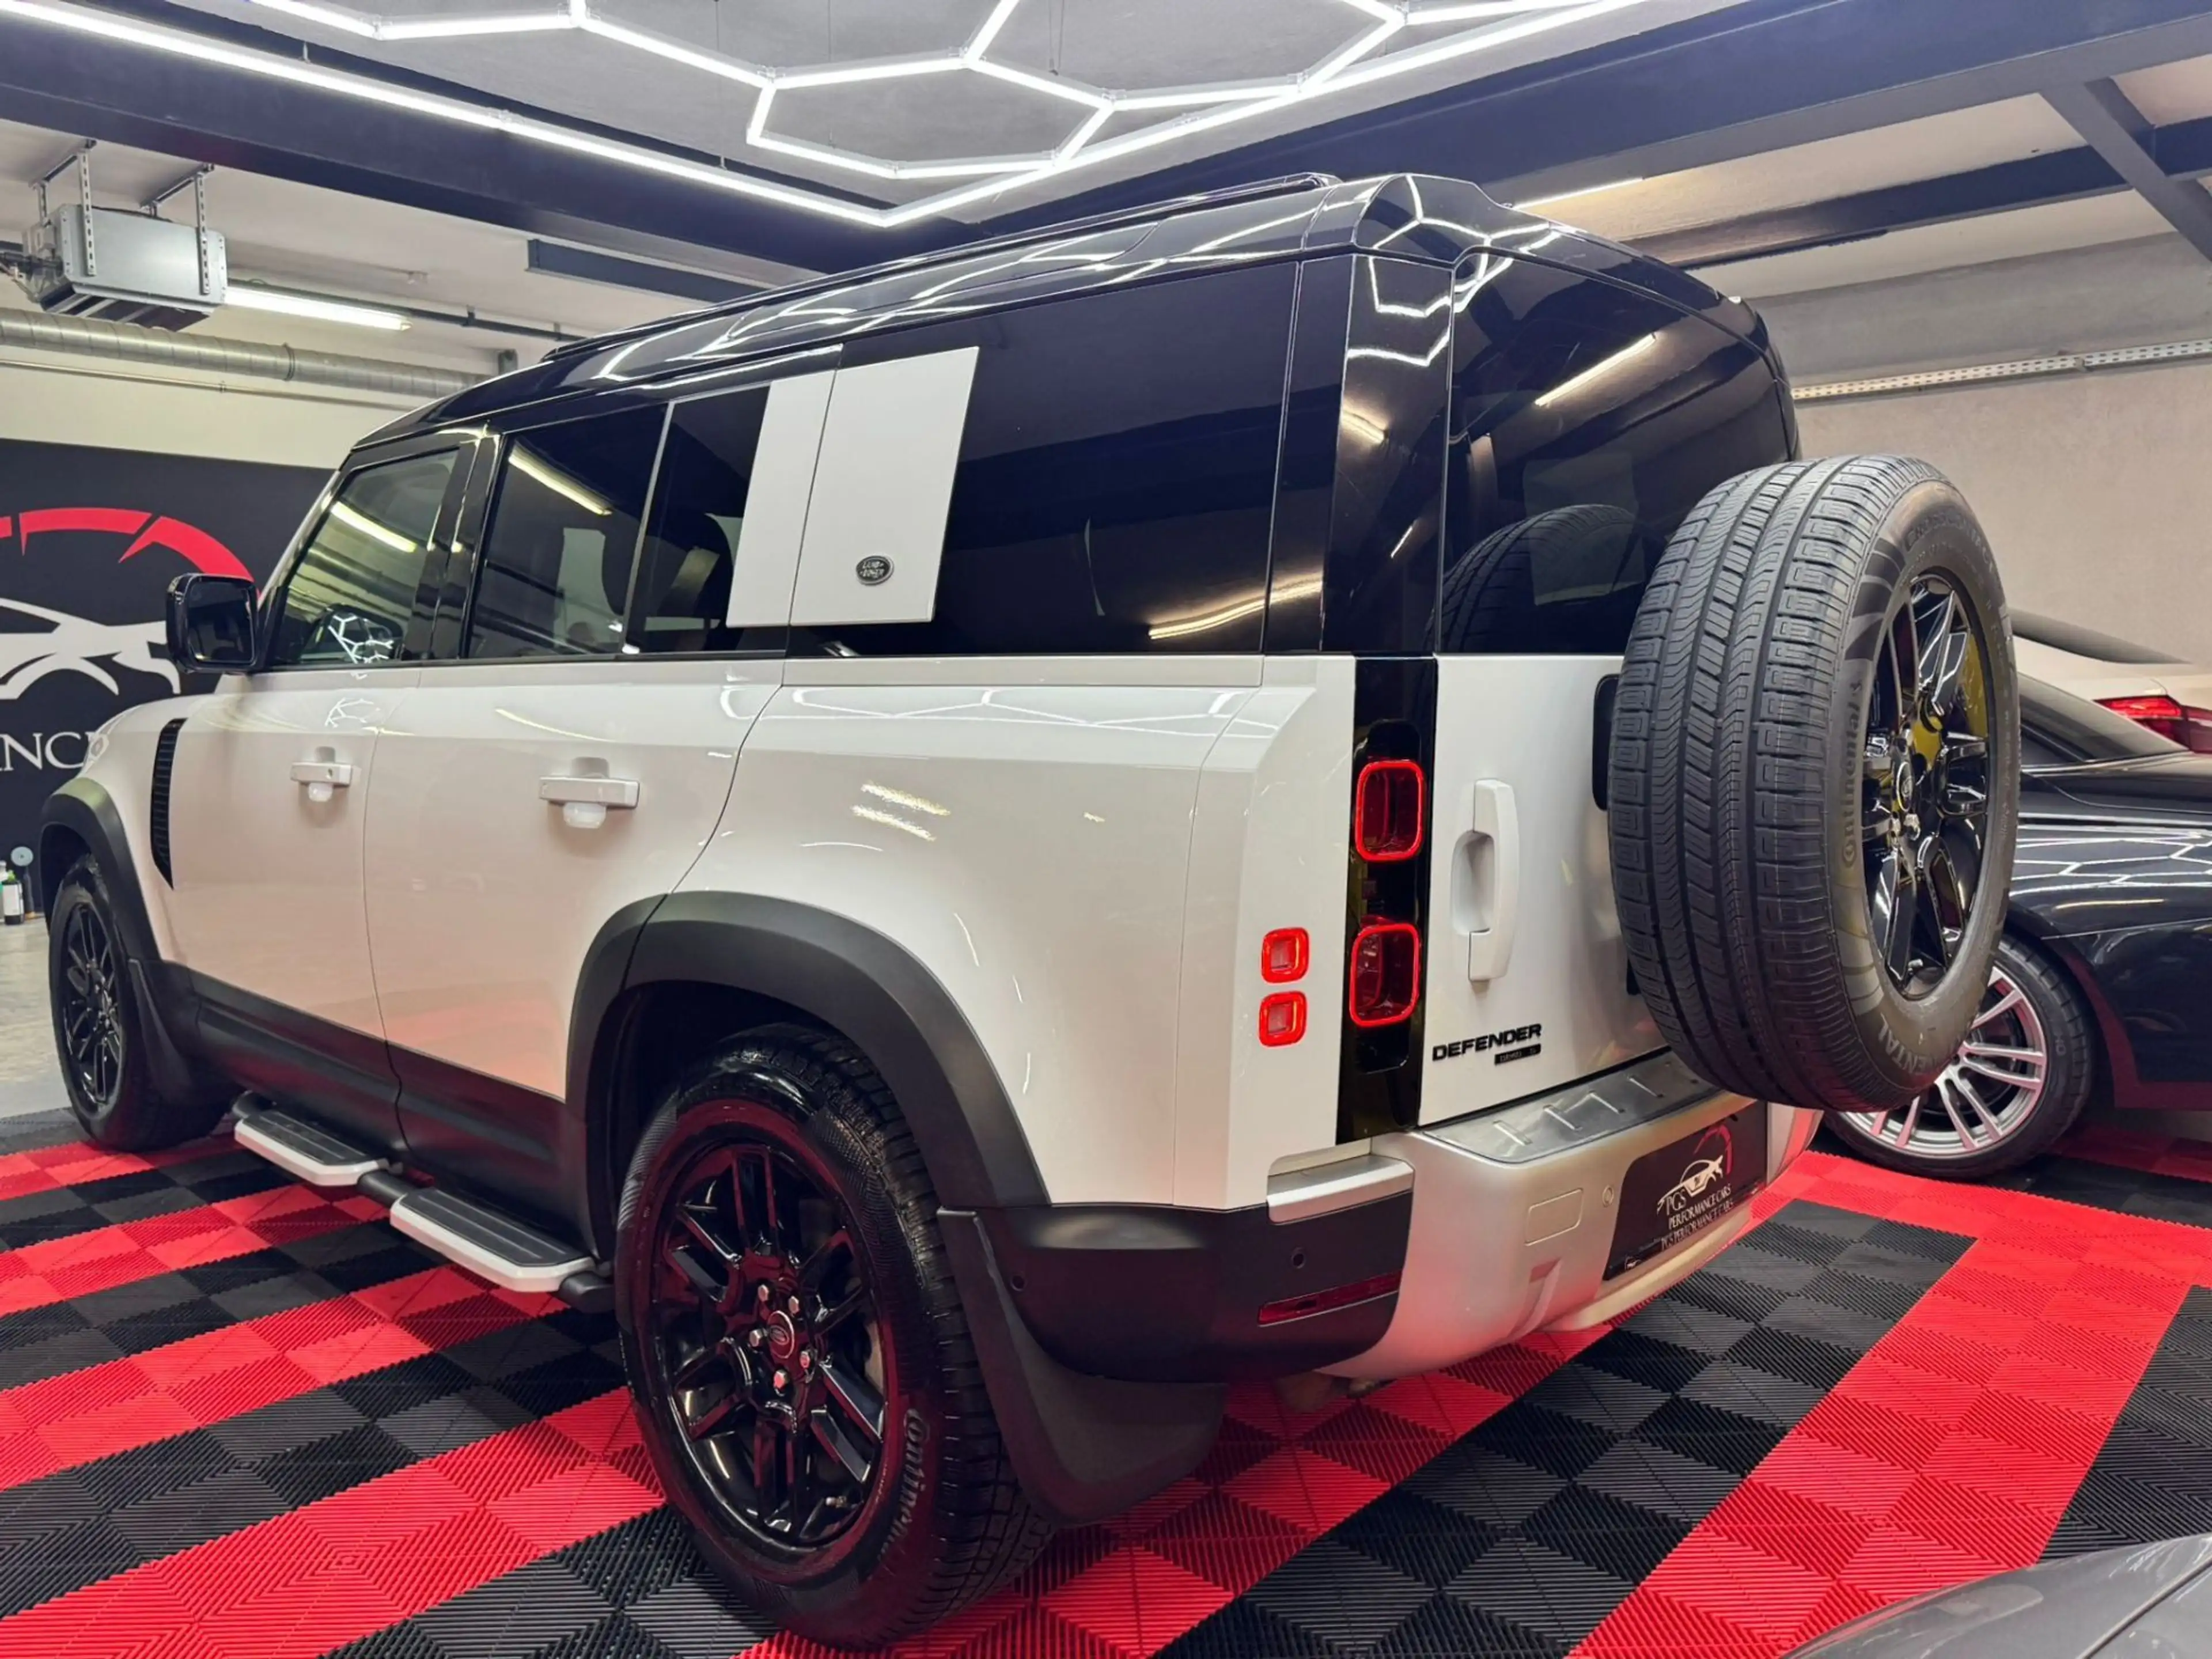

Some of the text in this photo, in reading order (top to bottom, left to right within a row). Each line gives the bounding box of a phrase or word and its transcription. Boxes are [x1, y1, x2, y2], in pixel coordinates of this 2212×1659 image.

[0, 731, 94, 771] NC
[1432, 1023, 1542, 1061] DEFENDER
[1668, 1193, 1716, 1230] PERFORMANCE
